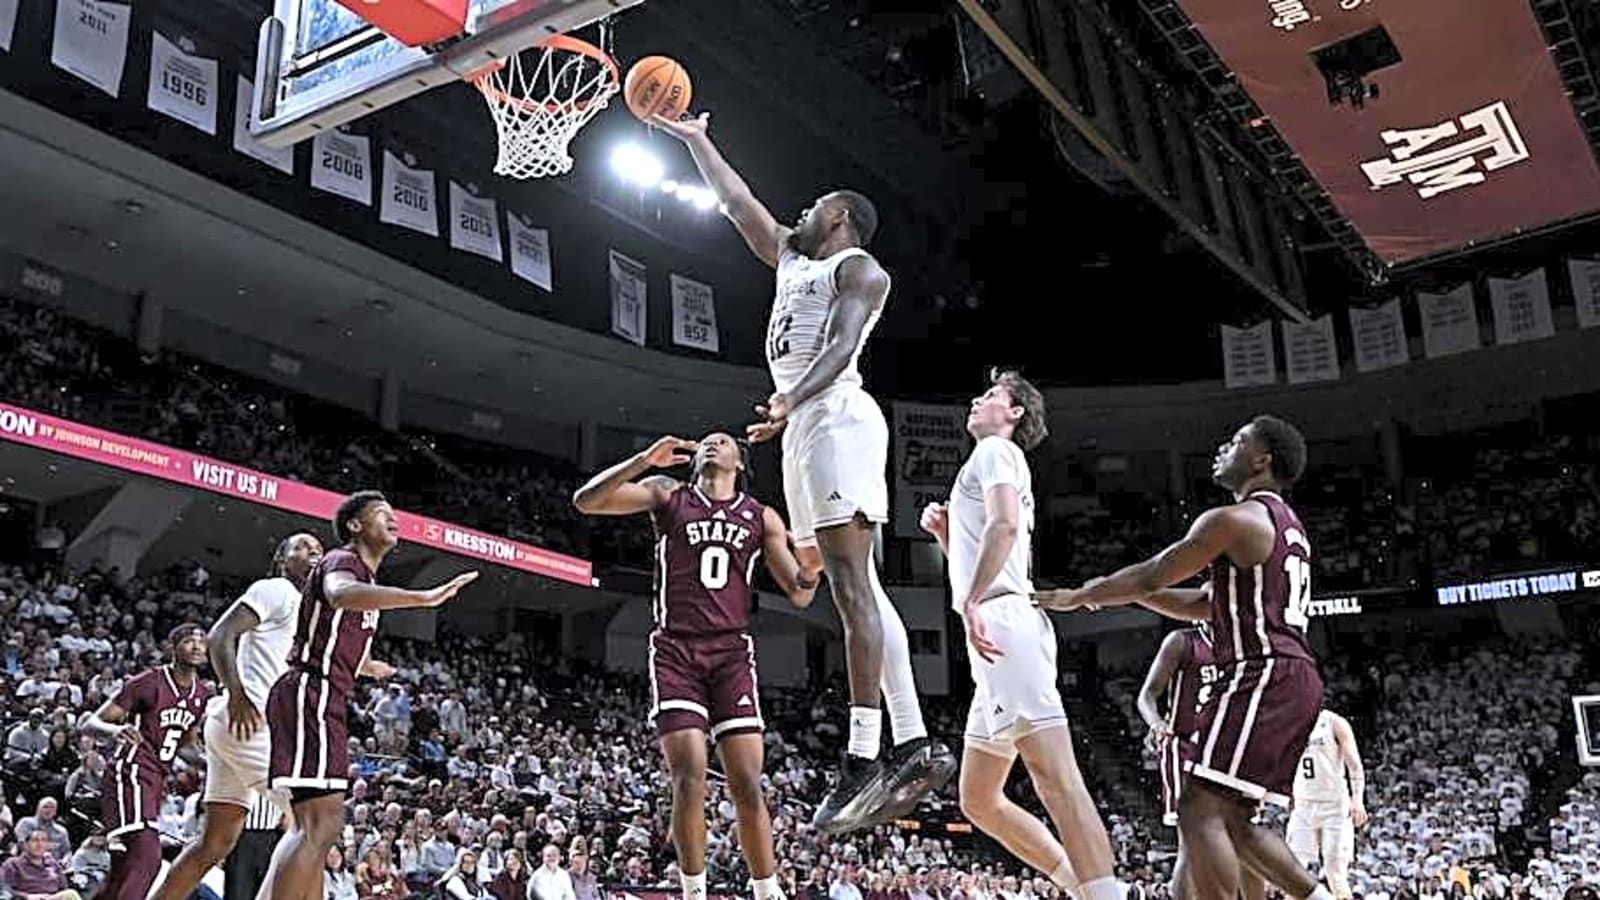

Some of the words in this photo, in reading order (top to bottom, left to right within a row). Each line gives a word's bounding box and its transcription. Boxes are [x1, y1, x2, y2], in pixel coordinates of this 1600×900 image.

[162, 70, 208, 106] 1996
[322, 150, 364, 181] 2008
[393, 184, 429, 212] 2010
[39, 425, 53, 437] BY
[54, 430, 100, 449] JOHNSON
[101, 440, 170, 467] DEVELOPMENT
[192, 460, 235, 489] VISIT
[236, 472, 257, 495] US
[261, 479, 278, 500] IN
[444, 528, 515, 561] KRESSTON
[686, 520, 750, 549] STATE
[700, 546, 729, 590] 0
[1437, 584, 1467, 605] BUY
[1468, 578, 1529, 601] TICKETS
[1529, 572, 1577, 595] TODAY
[1308, 597, 1362, 617] ETBALL
[159, 728, 182, 762] 5
[1302, 757, 1315, 779] 9
